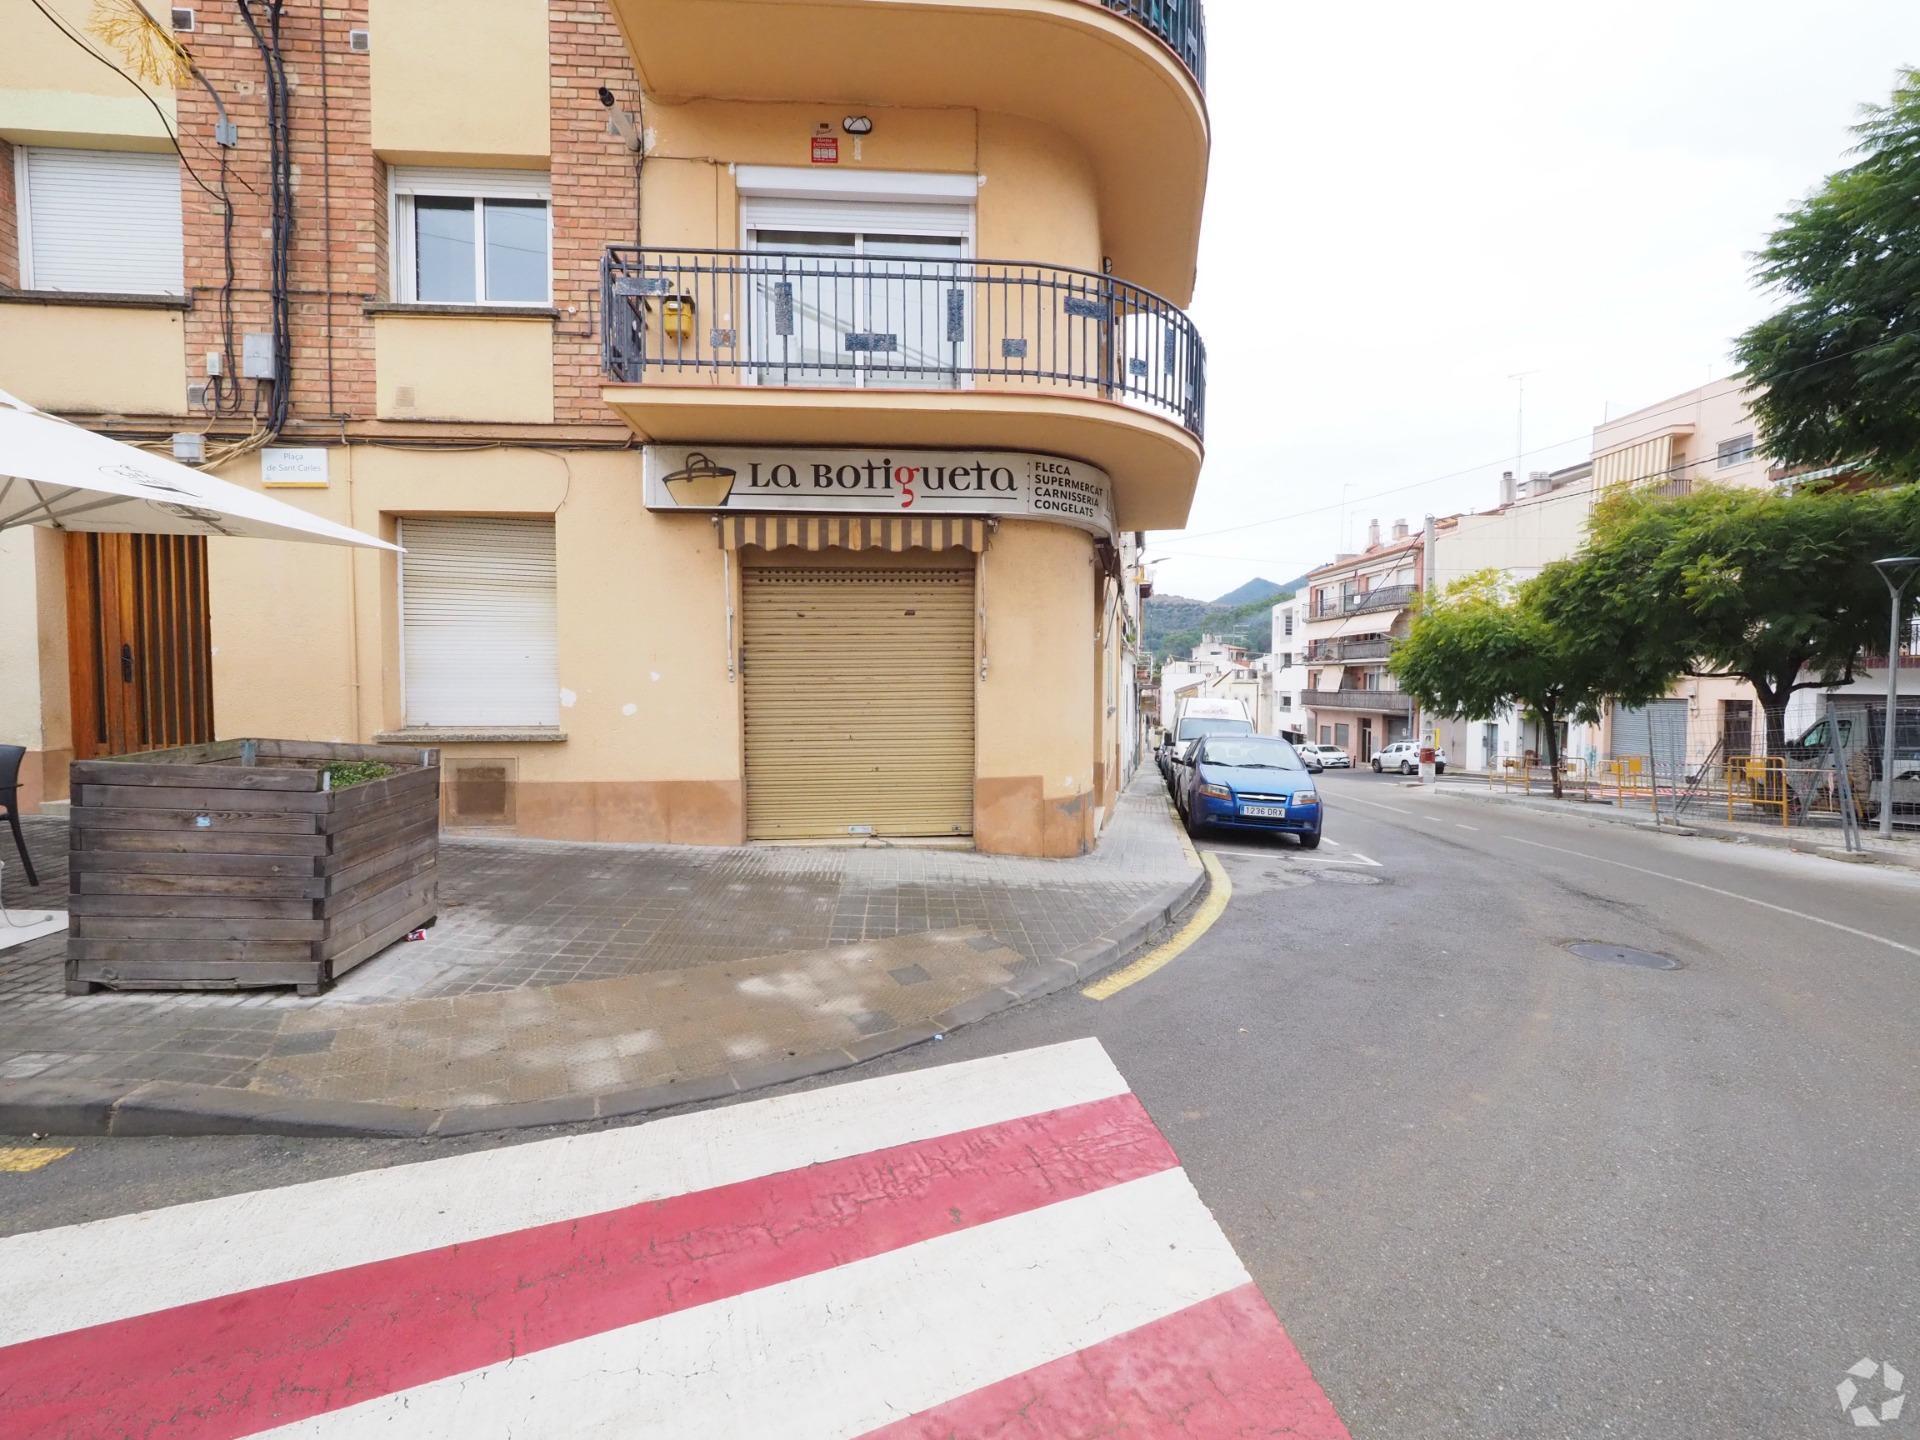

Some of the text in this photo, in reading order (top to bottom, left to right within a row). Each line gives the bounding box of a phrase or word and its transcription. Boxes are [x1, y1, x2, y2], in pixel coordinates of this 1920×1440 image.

[283, 452, 304, 463] Plaça
[266, 463, 321, 472] de Sant Carles
[1035, 461, 1071, 476] FLECA
[747, 457, 1018, 508] La Botigueta
[1034, 474, 1104, 497] SUPERMERCAT
[1034, 486, 1099, 508] CARNISSERIA
[1034, 499, 1095, 518] CONGELATS
[1246, 806, 1283, 817] 1236 DRX
